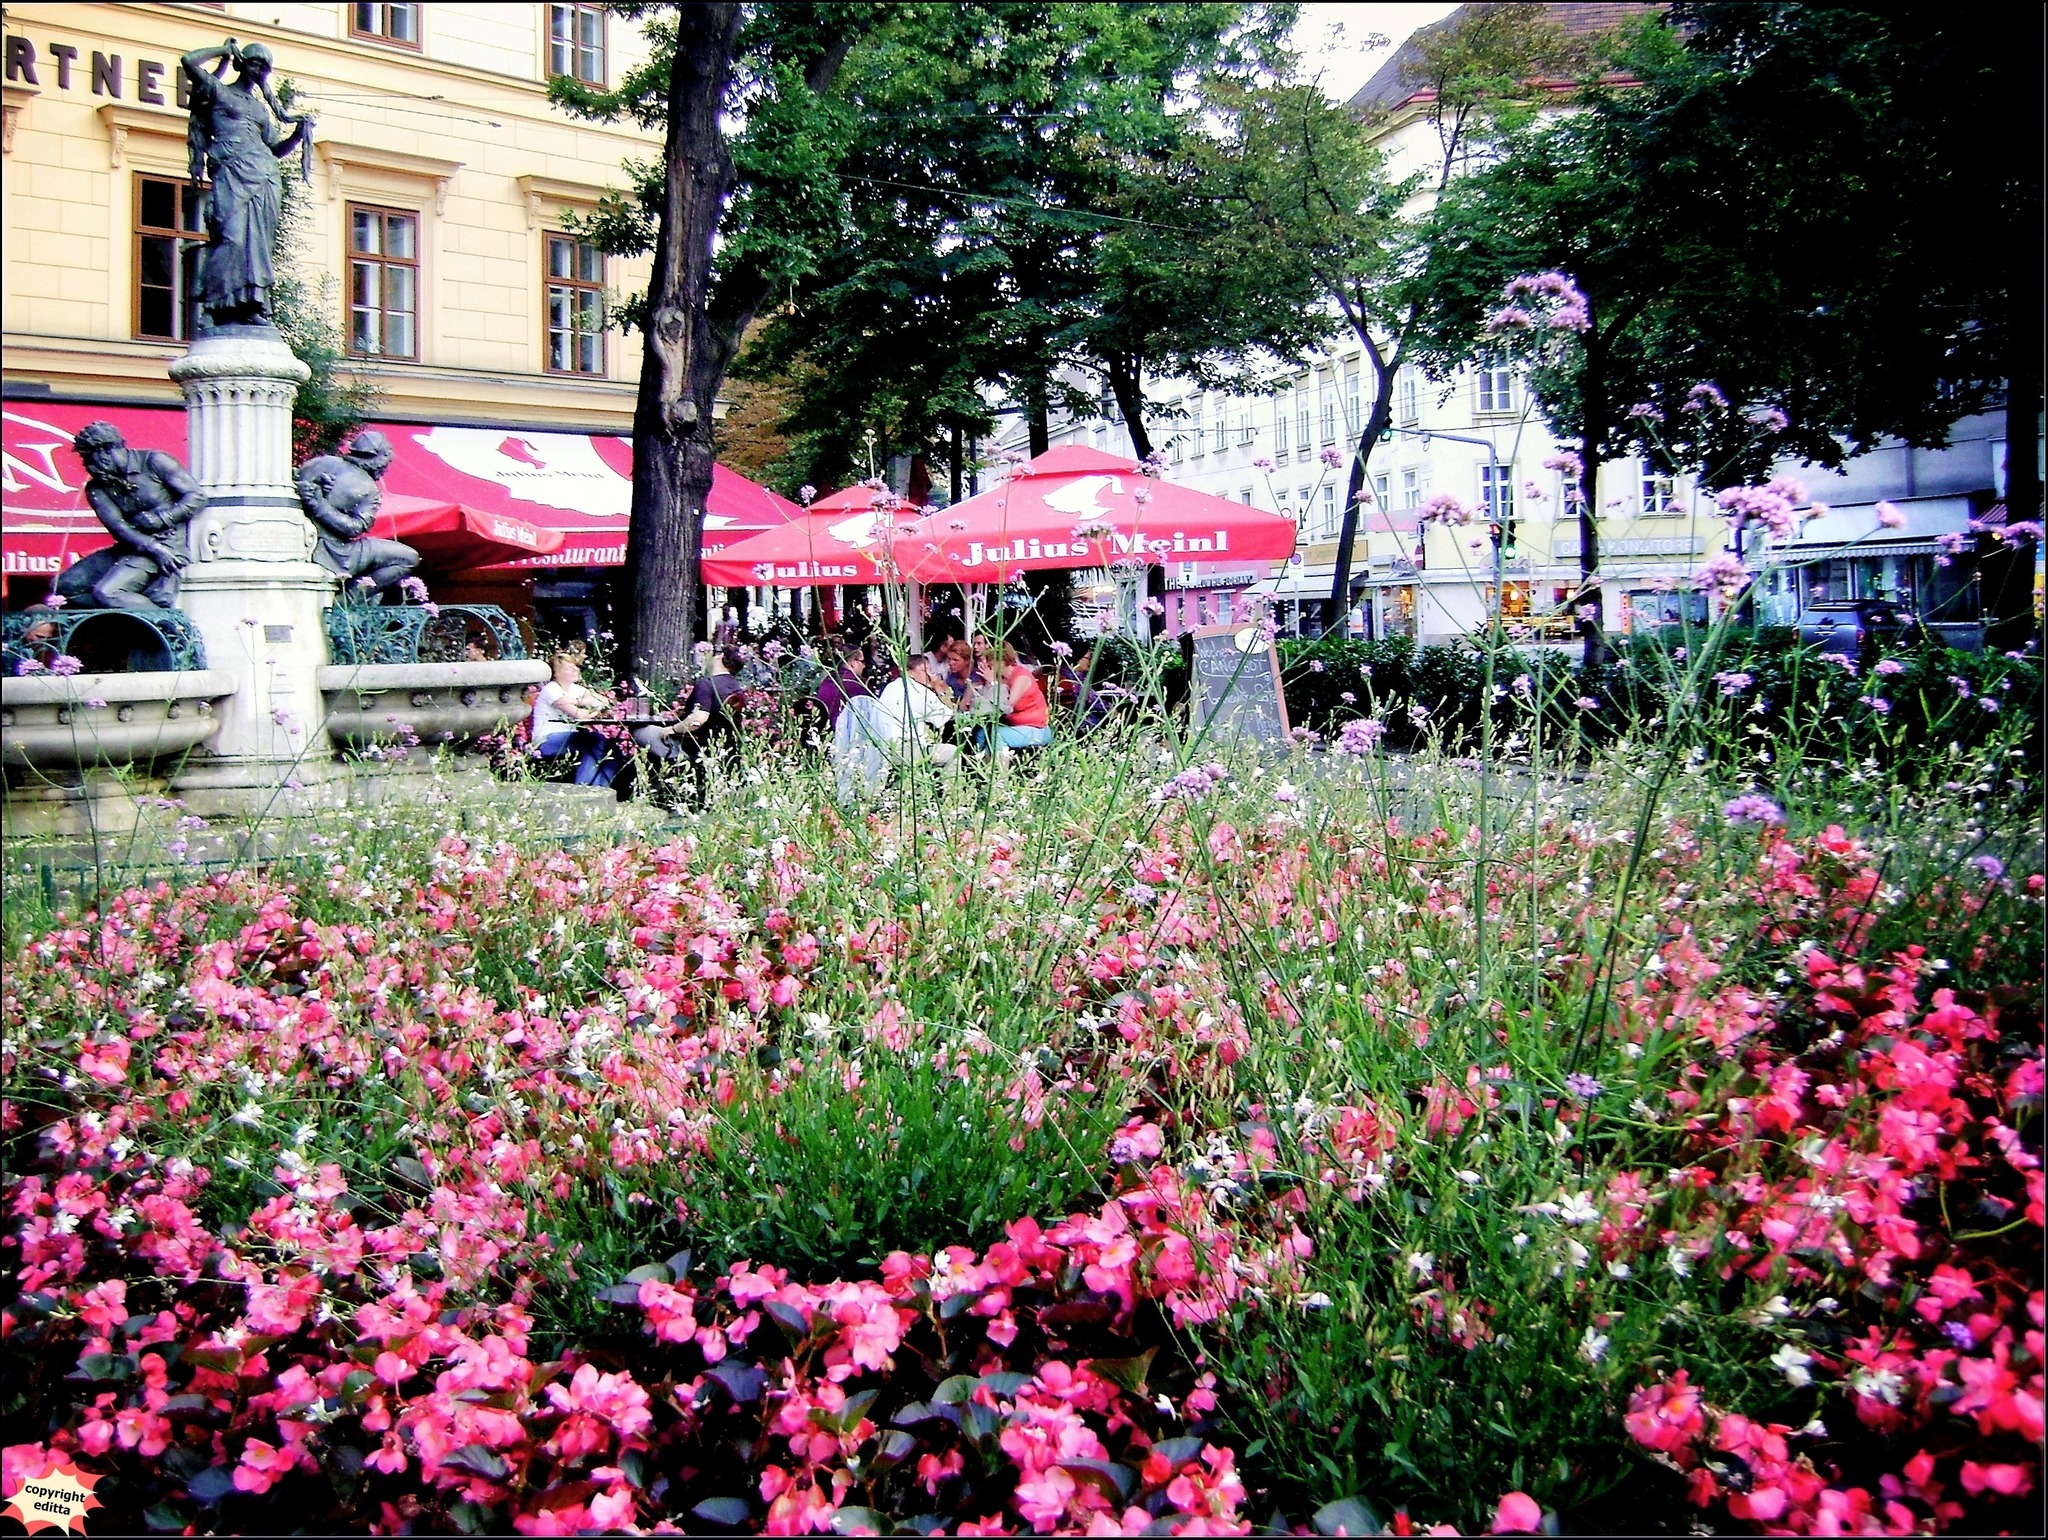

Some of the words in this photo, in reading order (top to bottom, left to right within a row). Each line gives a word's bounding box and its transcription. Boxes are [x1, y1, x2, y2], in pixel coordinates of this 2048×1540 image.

[961, 538, 1089, 567] Julius
[1110, 530, 1229, 555] Meinl
[754, 560, 858, 581] Julius
